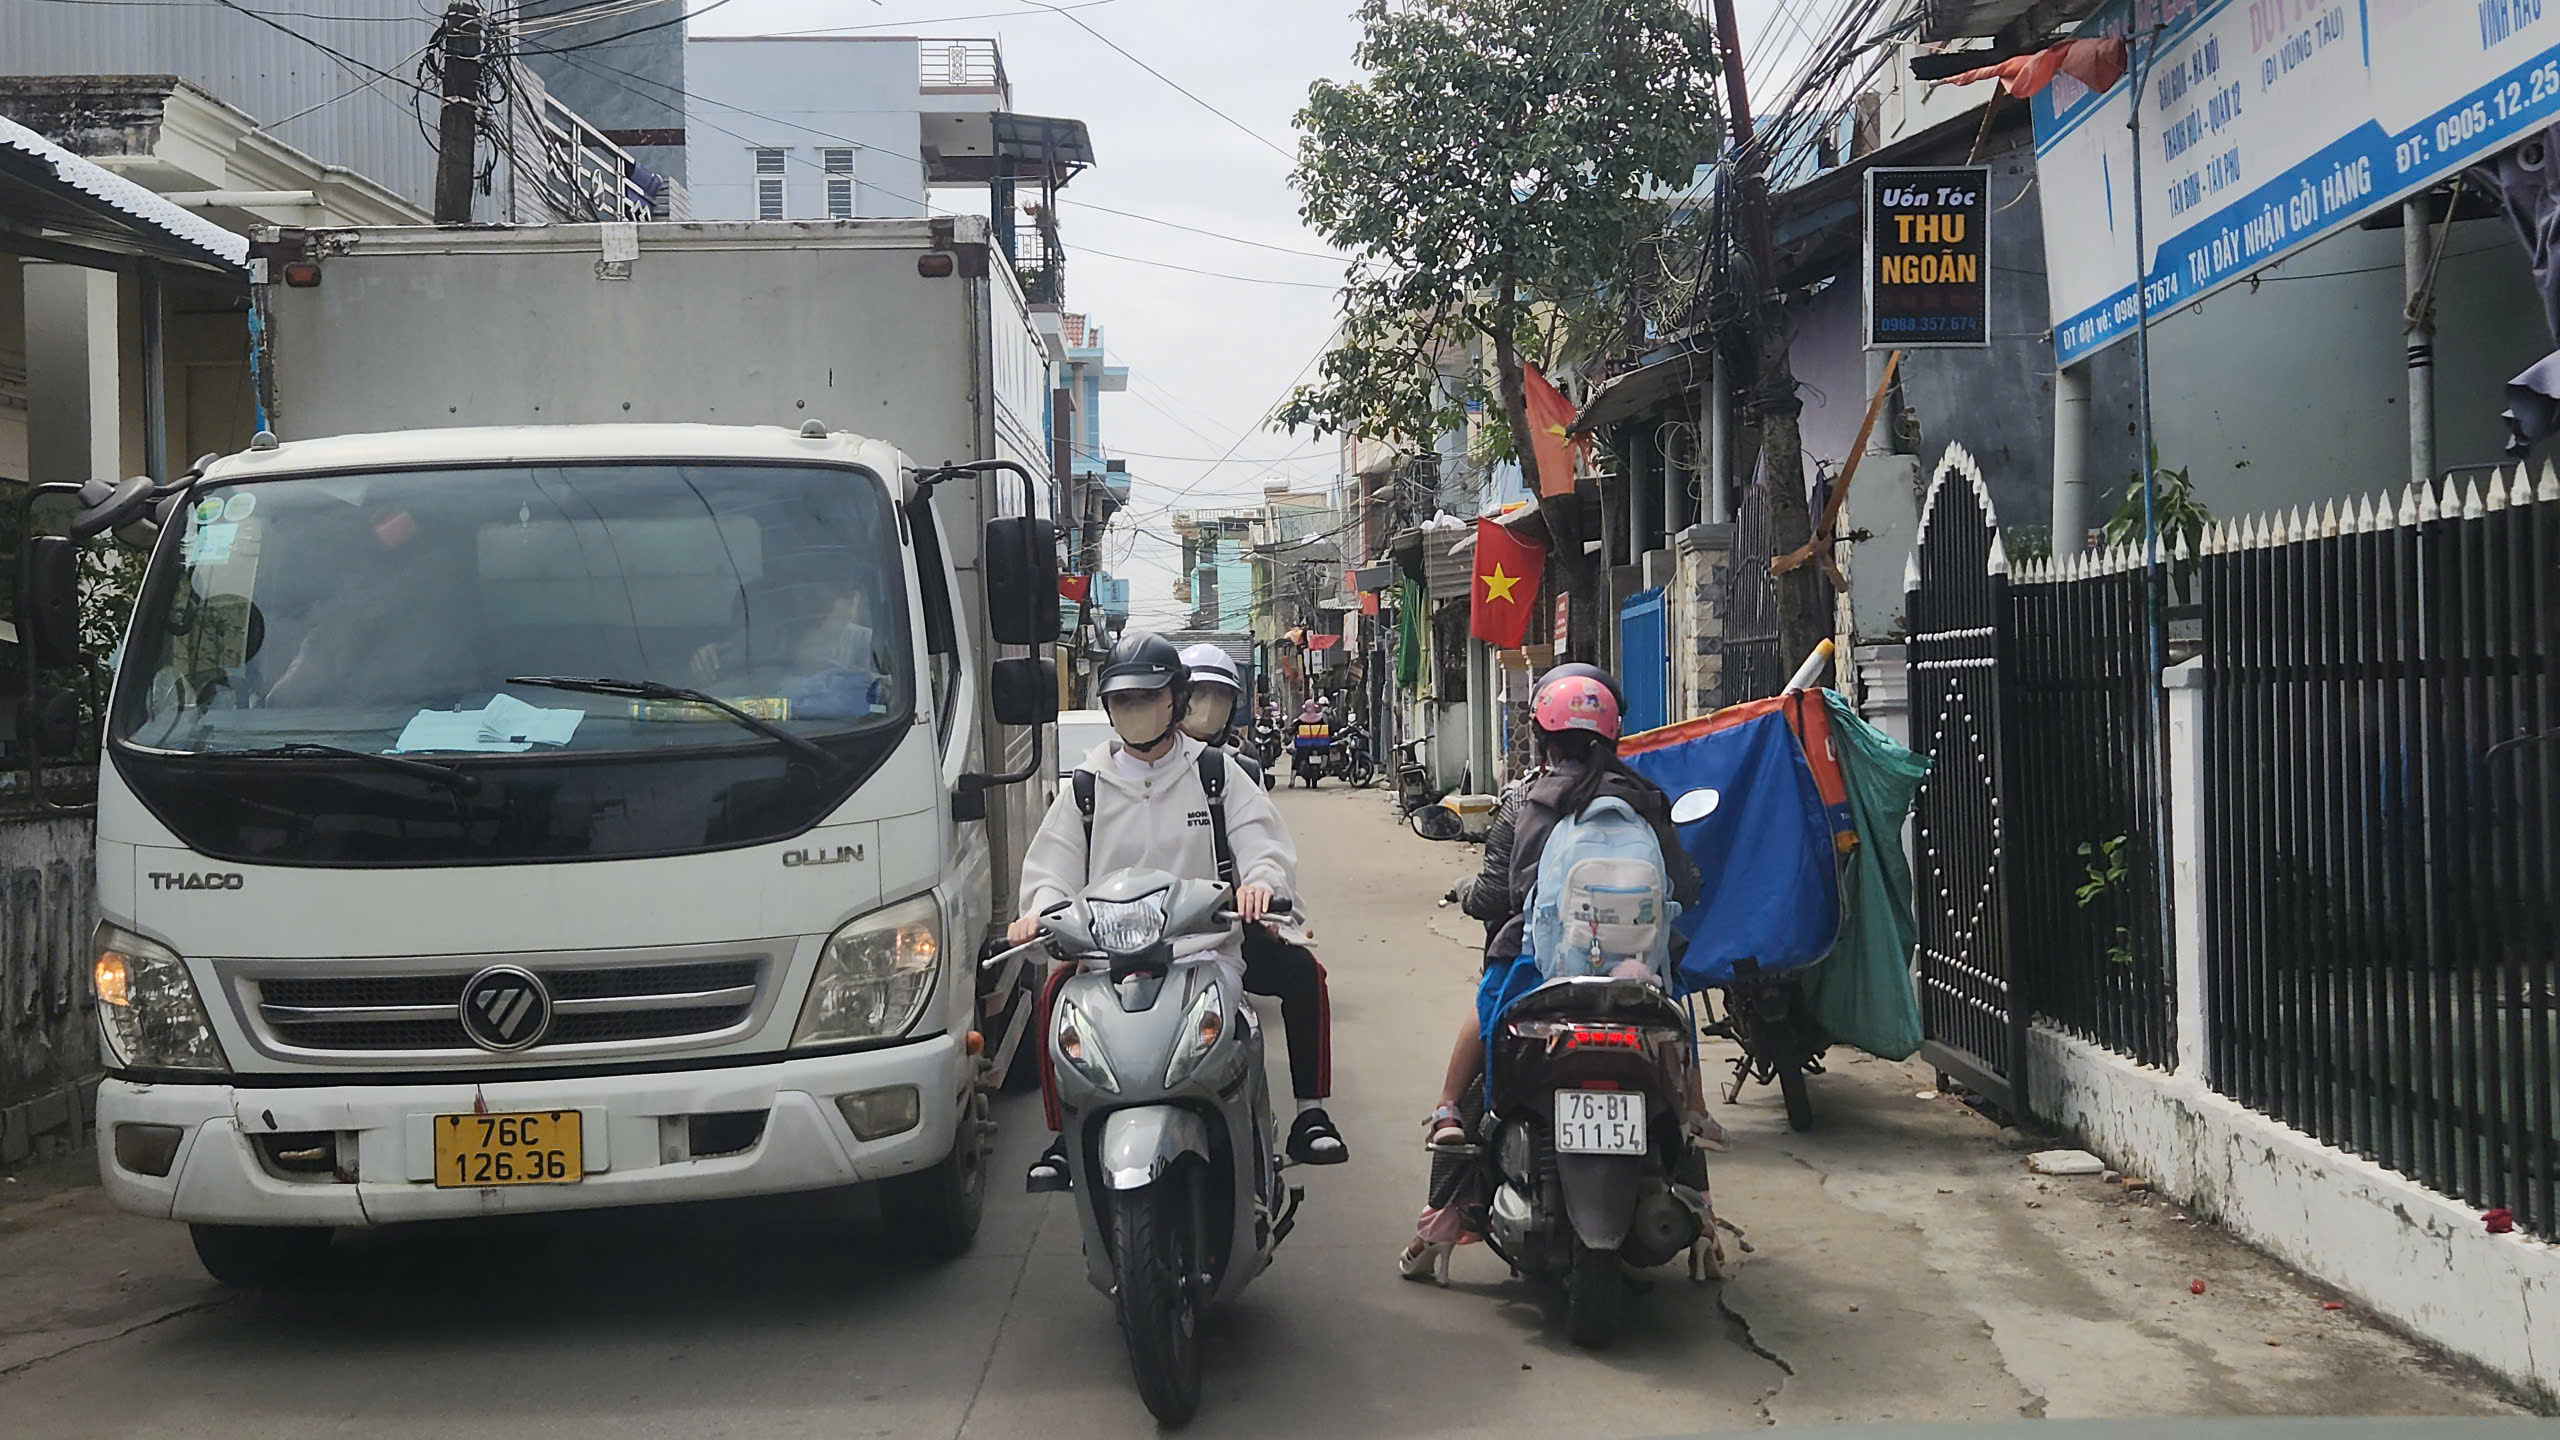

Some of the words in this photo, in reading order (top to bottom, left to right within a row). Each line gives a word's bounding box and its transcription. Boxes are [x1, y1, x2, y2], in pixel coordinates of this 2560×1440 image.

[2231, 80, 2242, 117] 12
[2396, 135, 2430, 174] ĐT:
[1882, 184, 1929, 207] Uốn
[1936, 184, 1976, 206] Tóc
[1893, 213, 1966, 244] THU
[2188, 245, 2211, 287] TẠI
[2213, 227, 2240, 272] ĐÂY
[2244, 203, 2286, 257] NHẬN
[2322, 155, 2372, 214] HÀNG
[1881, 249, 1977, 284] NGOÃN
[2114, 272, 2179, 324] 098857674
[1187, 811, 1208, 819] MON
[1187, 818, 1211, 827] STUD
[782, 844, 865, 867] OLLIN
[148, 872, 244, 891] THACO
[1569, 1094, 1629, 1121] 76-B1
[477, 1116, 539, 1148] 76C
[1562, 1123, 1641, 1150] 511.54
[455, 1150, 566, 1183] 126.36
